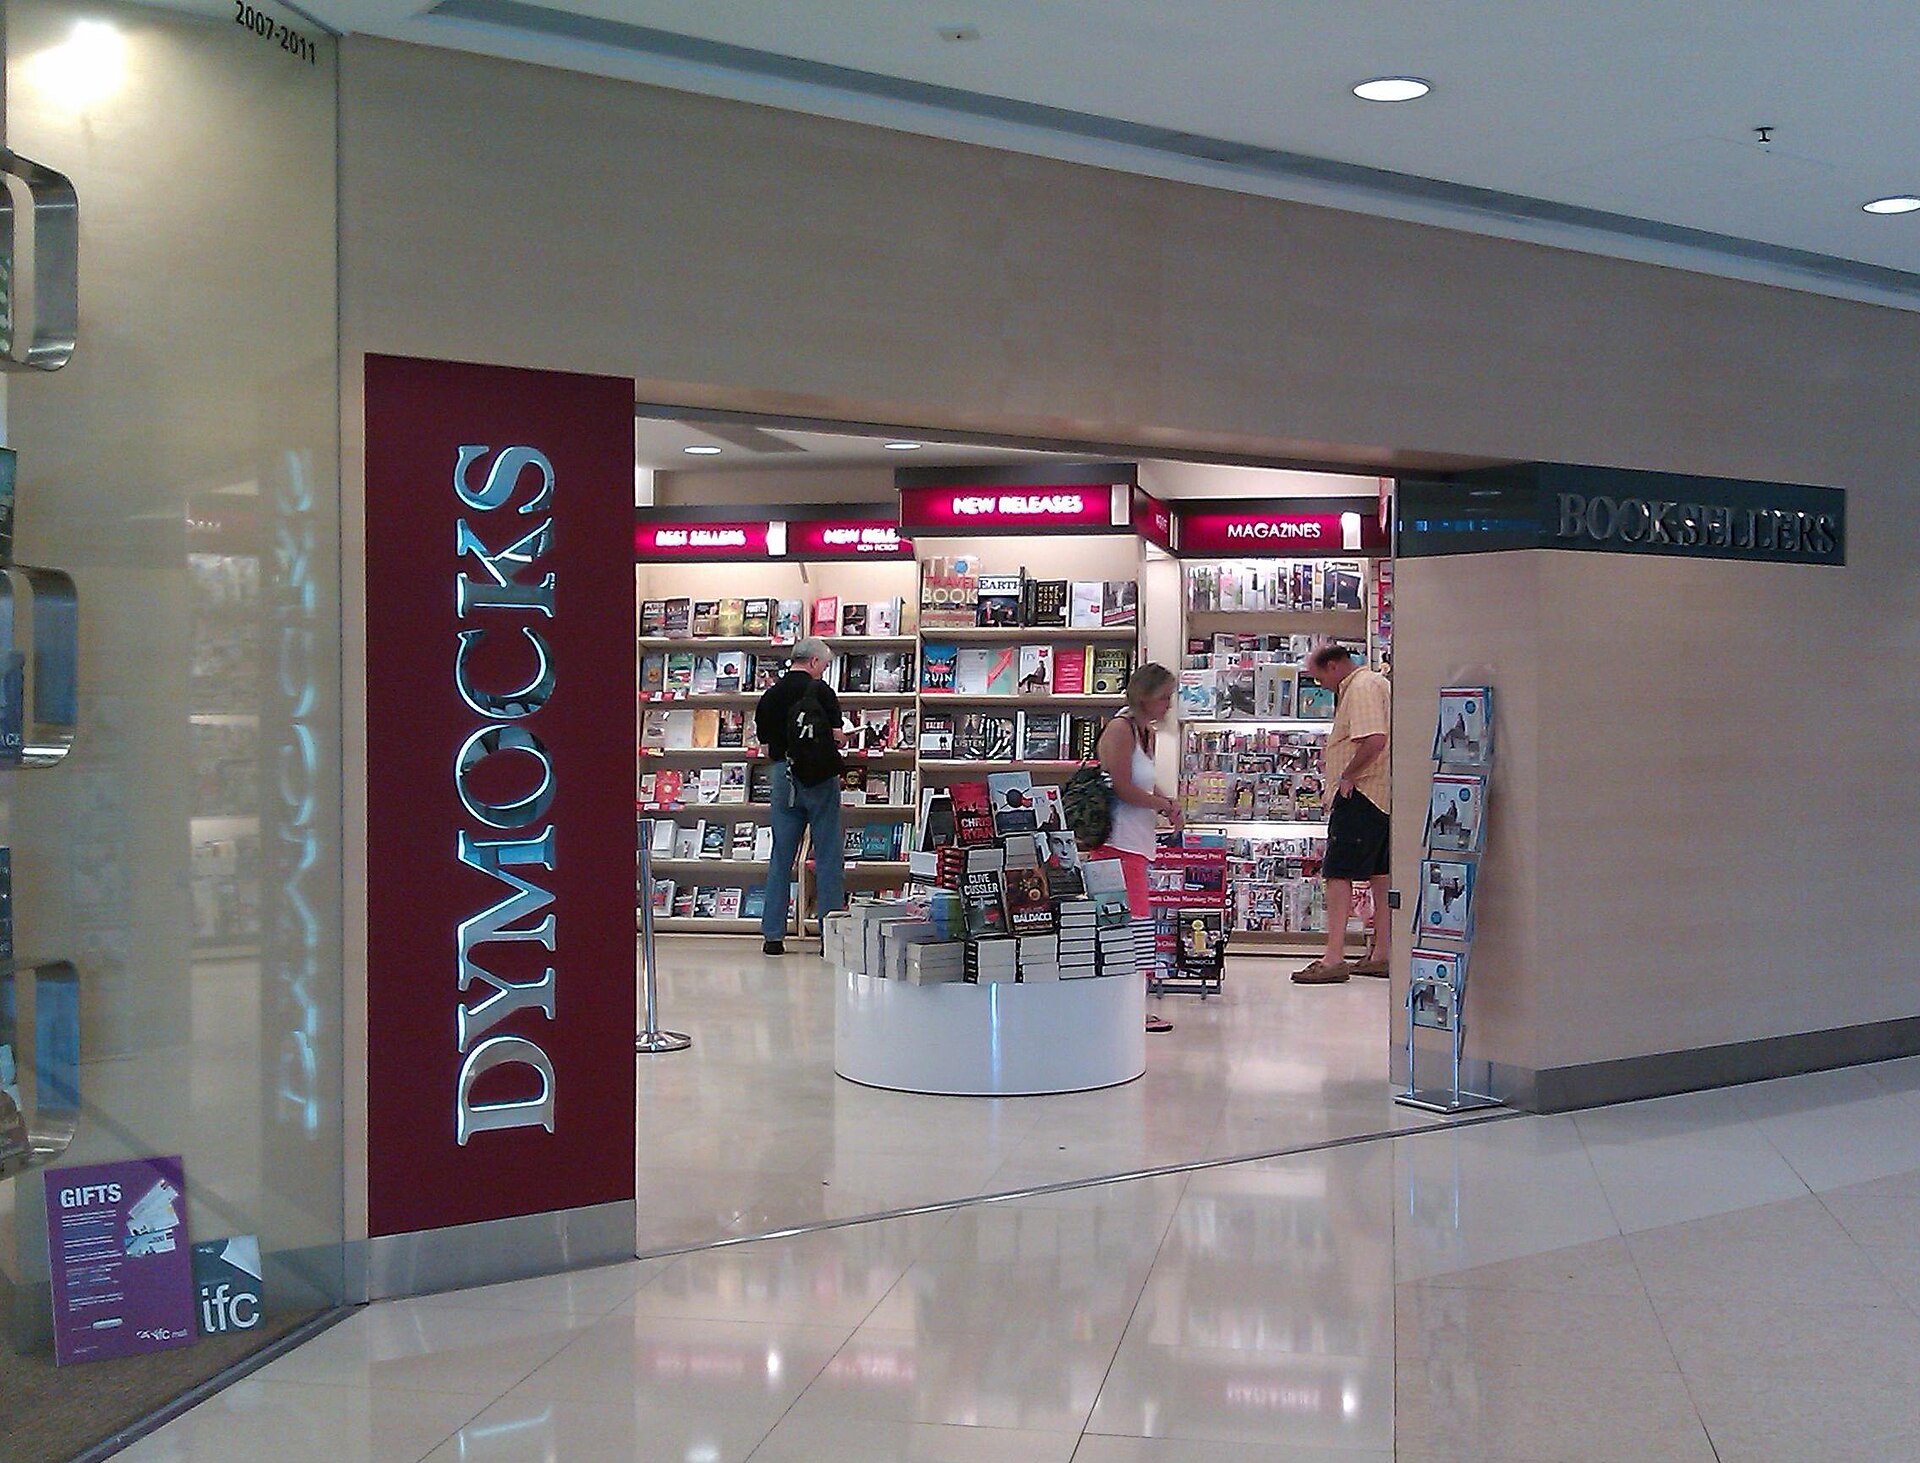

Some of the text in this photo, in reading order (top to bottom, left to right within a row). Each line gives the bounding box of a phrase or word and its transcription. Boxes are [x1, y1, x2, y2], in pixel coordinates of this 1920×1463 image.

[235, 0, 316, 65] 2007-2011
[952, 494, 1084, 515] NEW RELEASES
[1227, 522, 1321, 539] MAGAZINES
[1556, 491, 1839, 555] BOOKSELLERS
[655, 529, 747, 546] BEST SELLERS
[823, 528, 860, 544] NEW
[922, 588, 977, 604] BOOK
[924, 673, 953, 682] RUIN
[455, 444, 558, 1147] DYMOCKS
[961, 816, 992, 828] CHRIS
[968, 873, 990, 884] CLIVE
[963, 883, 999, 896] CUSSLER
[1013, 911, 1052, 923] BALDACCI
[60, 1183, 122, 1209] GIFTS
[201, 1284, 260, 1333] ifc
